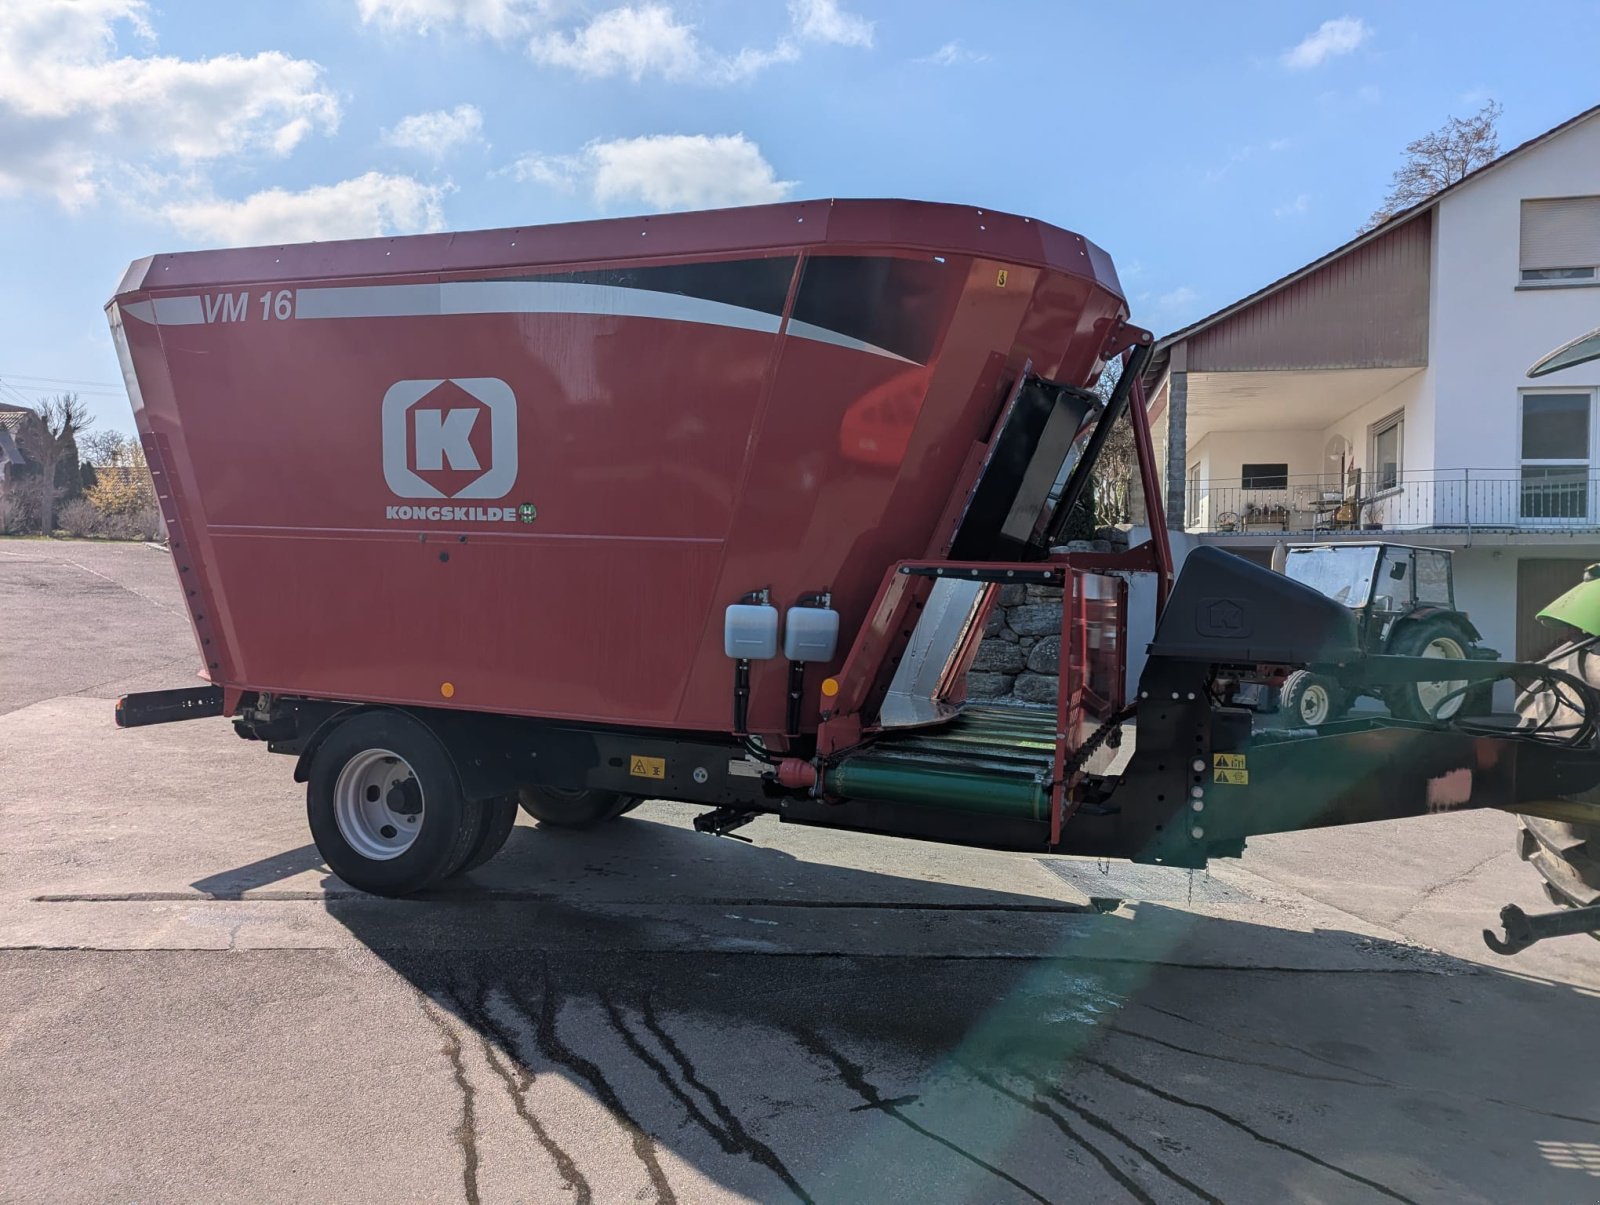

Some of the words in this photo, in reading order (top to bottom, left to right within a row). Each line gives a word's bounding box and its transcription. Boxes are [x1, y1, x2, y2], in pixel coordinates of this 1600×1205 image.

[204, 292, 249, 324] VM
[260, 289, 292, 321] 16
[415, 408, 482, 471] K
[386, 505, 517, 522] KONGSKILDE
